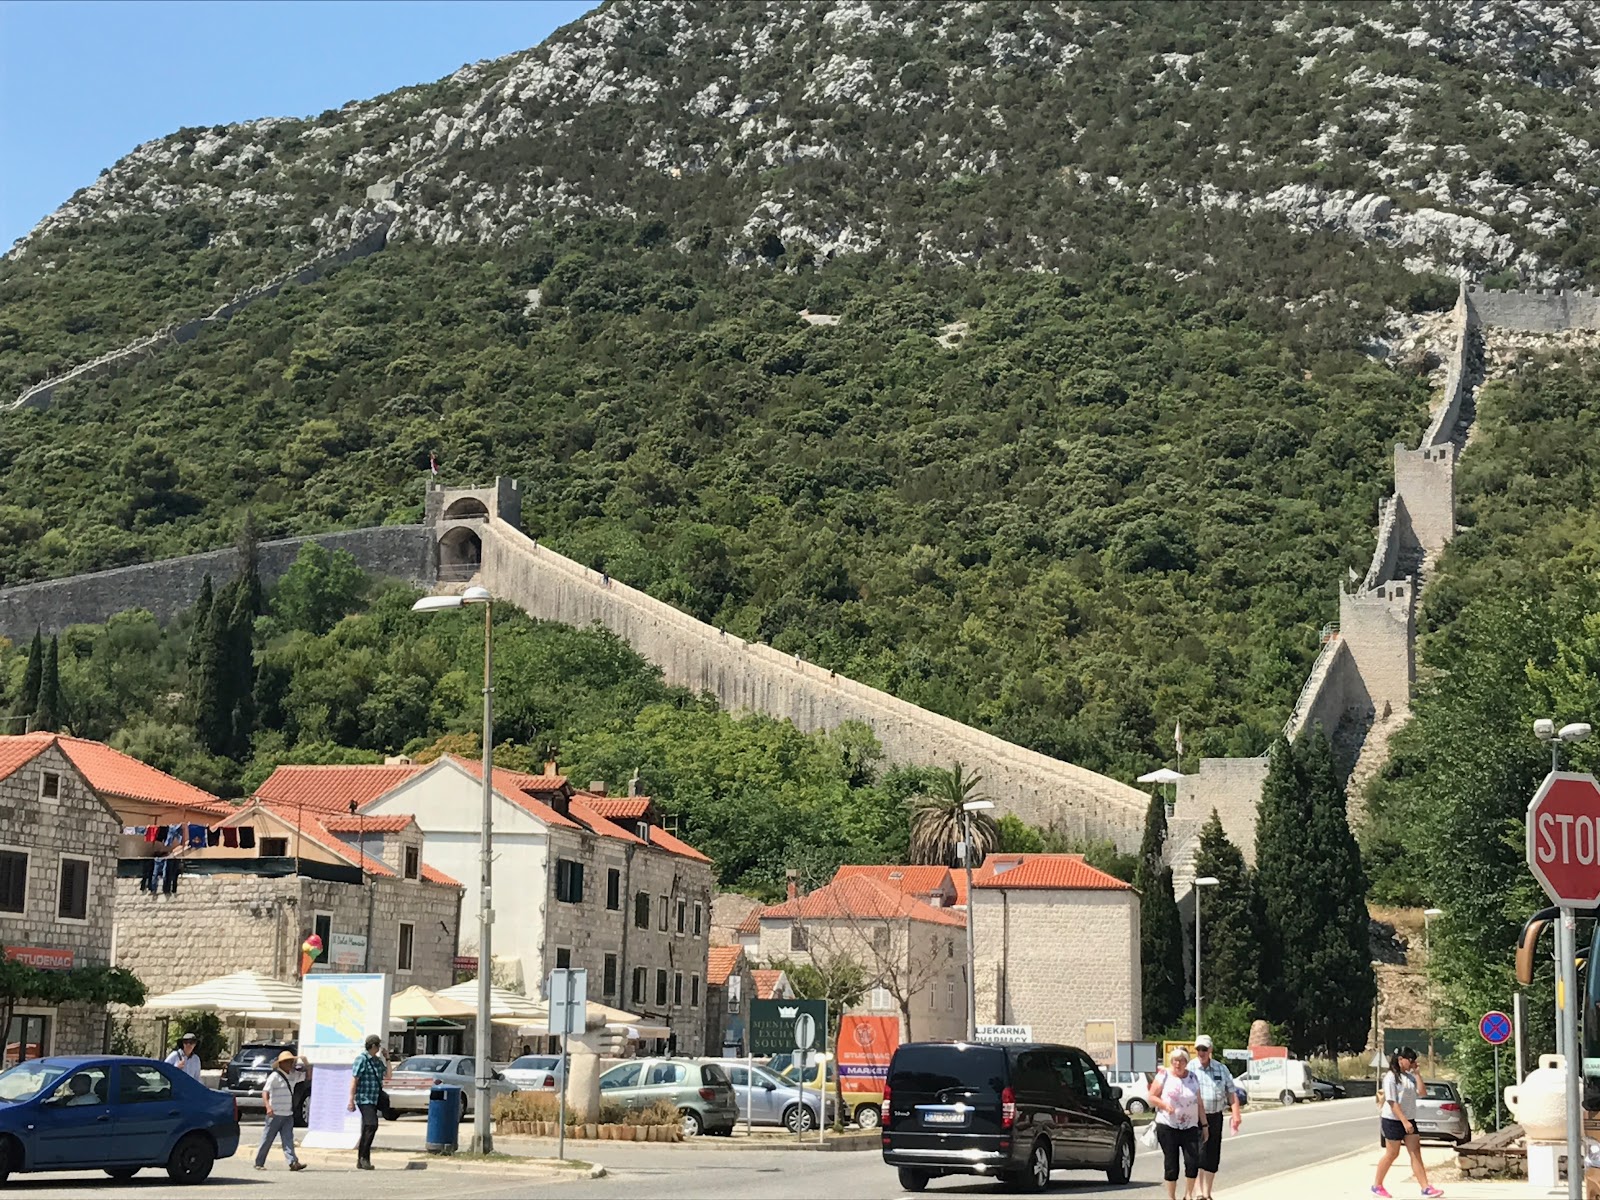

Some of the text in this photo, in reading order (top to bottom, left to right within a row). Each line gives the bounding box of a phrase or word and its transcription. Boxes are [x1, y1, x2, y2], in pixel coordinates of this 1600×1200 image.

[16, 953, 71, 967] STUDENAC
[975, 1027, 1026, 1035] LJEKARNA
[847, 1067, 889, 1075] MARKET
